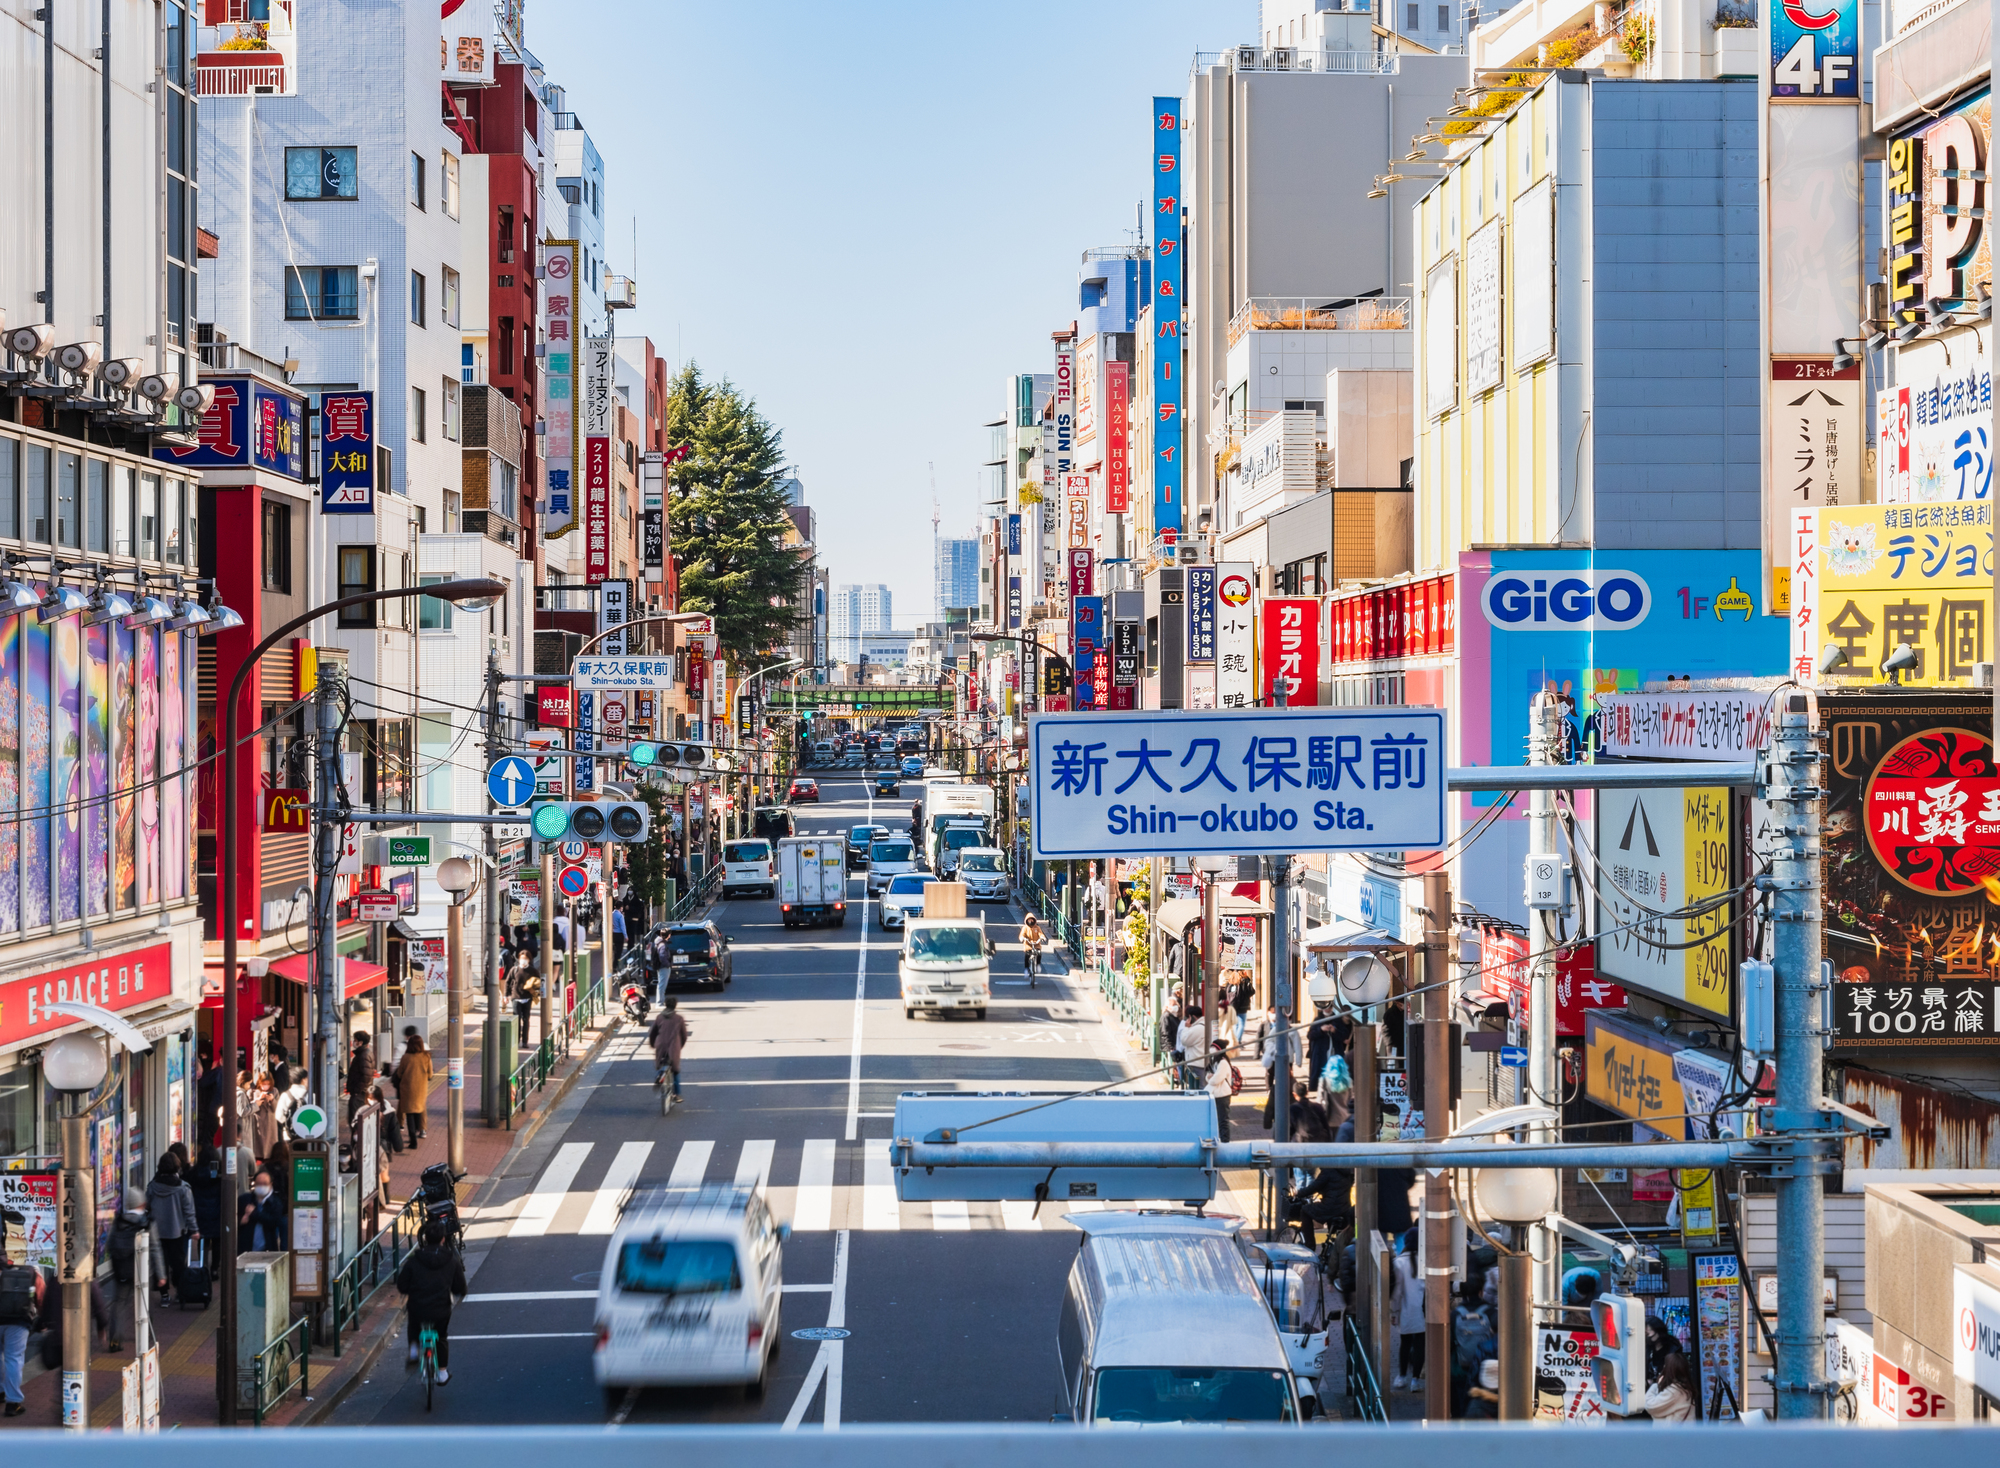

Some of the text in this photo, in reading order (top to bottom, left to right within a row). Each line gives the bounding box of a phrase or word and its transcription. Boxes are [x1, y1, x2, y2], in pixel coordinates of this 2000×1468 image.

[1775, 34, 1853, 94] 4F
[548, 295, 570, 342] 家具
[588, 341, 607, 349] INC
[548, 352, 570, 400] 電器
[1058, 354, 1070, 404] HOTEL
[1795, 364, 1815, 377] 2F
[325, 396, 370, 442] 質
[1058, 414, 1070, 451] SUN
[1112, 378, 1122, 506] PLAZA HOTEL
[328, 451, 367, 473] 大和
[548, 469, 570, 515] 寝具
[1068, 486, 1088, 495] OPEN
[1070, 477, 1086, 487] 24h
[339, 489, 365, 502] 入口
[1076, 568, 1087, 595] Caf
[1490, 578, 1643, 623] GiGO
[1677, 586, 1708, 619] 1F
[1720, 598, 1747, 606] GAME
[1795, 515, 1814, 680] エレベーター有
[1201, 571, 1213, 658] カンナム整体院
[1280, 605, 1302, 696] カラオケ
[577, 661, 668, 676] 新大久保駅前
[1119, 659, 1135, 669] XU
[590, 677, 656, 685] Shin-okubo Sta.
[1094, 653, 1109, 705] 中華物産
[1052, 732, 1428, 796] 新大久保駅前
[1875, 791, 1916, 801] 四川料理
[1108, 801, 1374, 835] Shin-okubo Sta.
[566, 843, 582, 856] 40
[1538, 891, 1552, 899] 13P
[1225, 918, 1240, 927] No
[1225, 926, 1252, 934] Smoking
[412, 942, 427, 951] No
[1848, 987, 1985, 1011] 貸切最大
[1848, 1009, 1984, 1034] 100名様
[3, 1179, 30, 1194] No
[5, 1194, 53, 1206] Smoking
[18, 1204, 31, 1212] the
[1545, 1333, 1579, 1354] No
[1542, 1368, 1556, 1377] On
[1560, 1369, 1575, 1377] the
[1905, 1386, 1946, 1418] 3F
